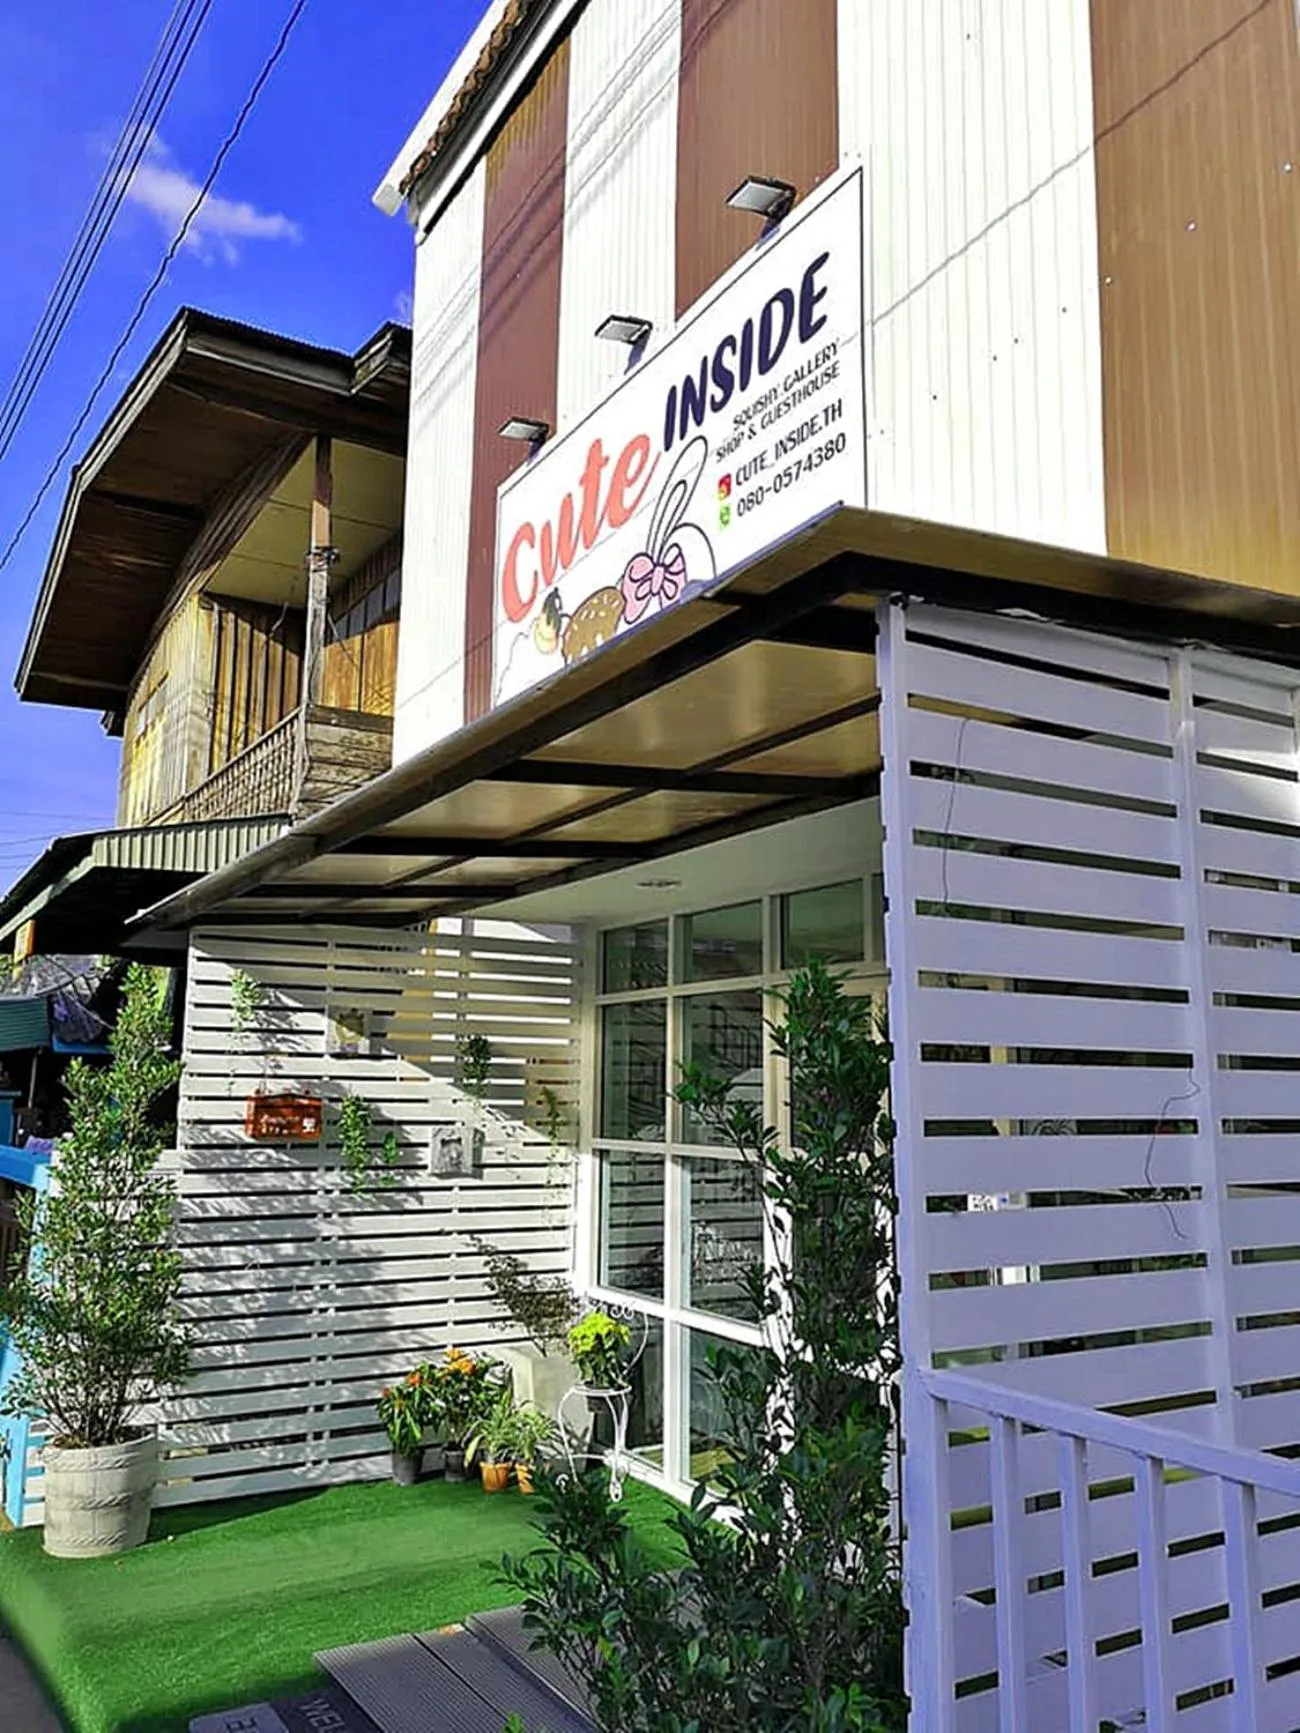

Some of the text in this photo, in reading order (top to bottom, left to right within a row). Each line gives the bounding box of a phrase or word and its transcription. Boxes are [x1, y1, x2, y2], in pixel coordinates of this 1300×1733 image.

[716, 359, 840, 463] SHOP & GUESTHOUSE
[732, 337, 840, 431] SQUISHY GALLERY
[503, 251, 830, 623] Cute INSIDE
[737, 432, 846, 517] 080-0574380
